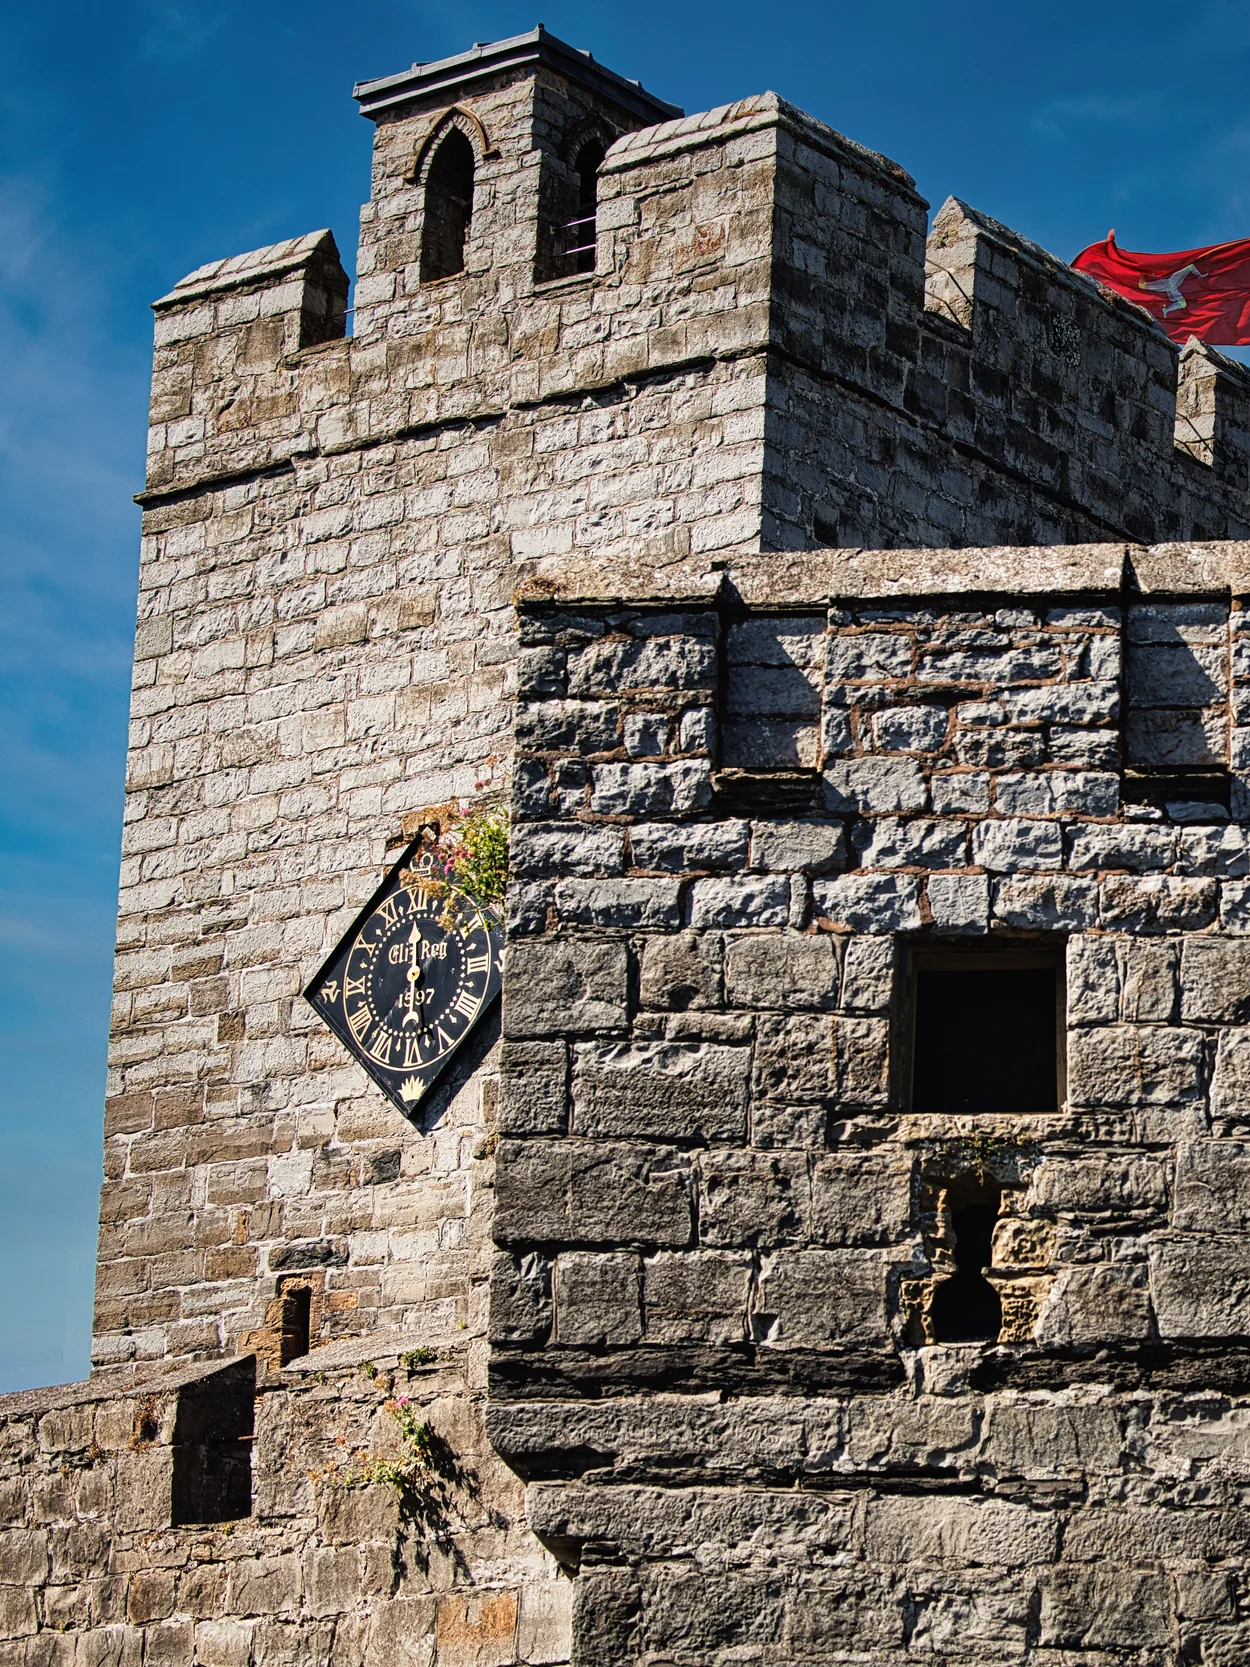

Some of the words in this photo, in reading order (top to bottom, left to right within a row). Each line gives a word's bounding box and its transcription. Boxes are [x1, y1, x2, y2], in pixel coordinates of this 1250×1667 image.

[376, 898, 399, 930] XI
[406, 886, 428, 914] XII
[354, 933, 377, 957] X
[421, 939, 448, 960] Reg
[467, 952, 489, 975] III
[345, 975, 366, 999] IX
[398, 987, 435, 1008] 1597
[453, 988, 482, 1022] IIII
[349, 1004, 373, 1042] VIII
[369, 1030, 392, 1064] VII
[402, 1038, 424, 1067] VI
[437, 1025, 455, 1055] V
